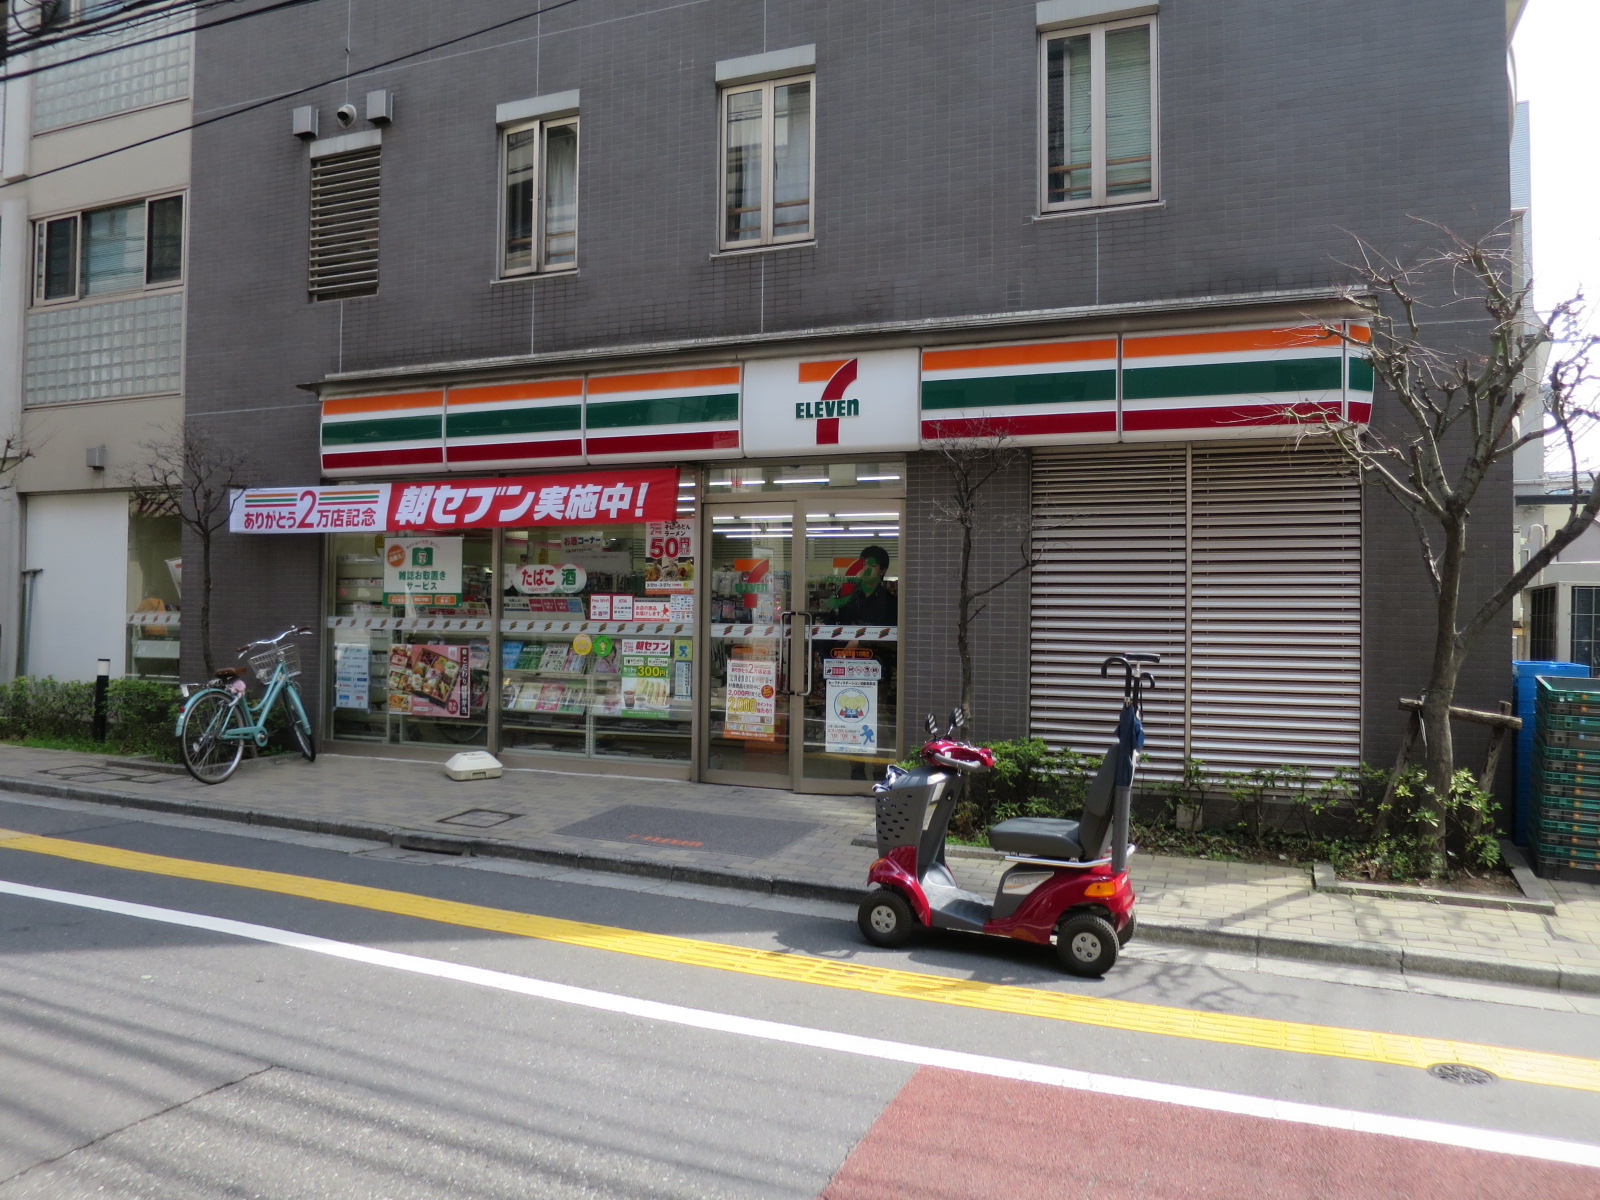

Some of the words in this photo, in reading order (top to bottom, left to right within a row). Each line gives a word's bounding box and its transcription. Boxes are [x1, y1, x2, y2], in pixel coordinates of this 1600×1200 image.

[244, 490, 376, 529] ありがとう2万店記念
[395, 482, 649, 524] 朝セブン実施中!
[399, 571, 446, 580] 雑誌お取置き
[522, 569, 554, 586] たばこ
[562, 569, 576, 585] 酒
[407, 582, 437, 591] サービス
[636, 641, 669, 651] 朝セブン
[728, 697, 757, 714] 2,000
